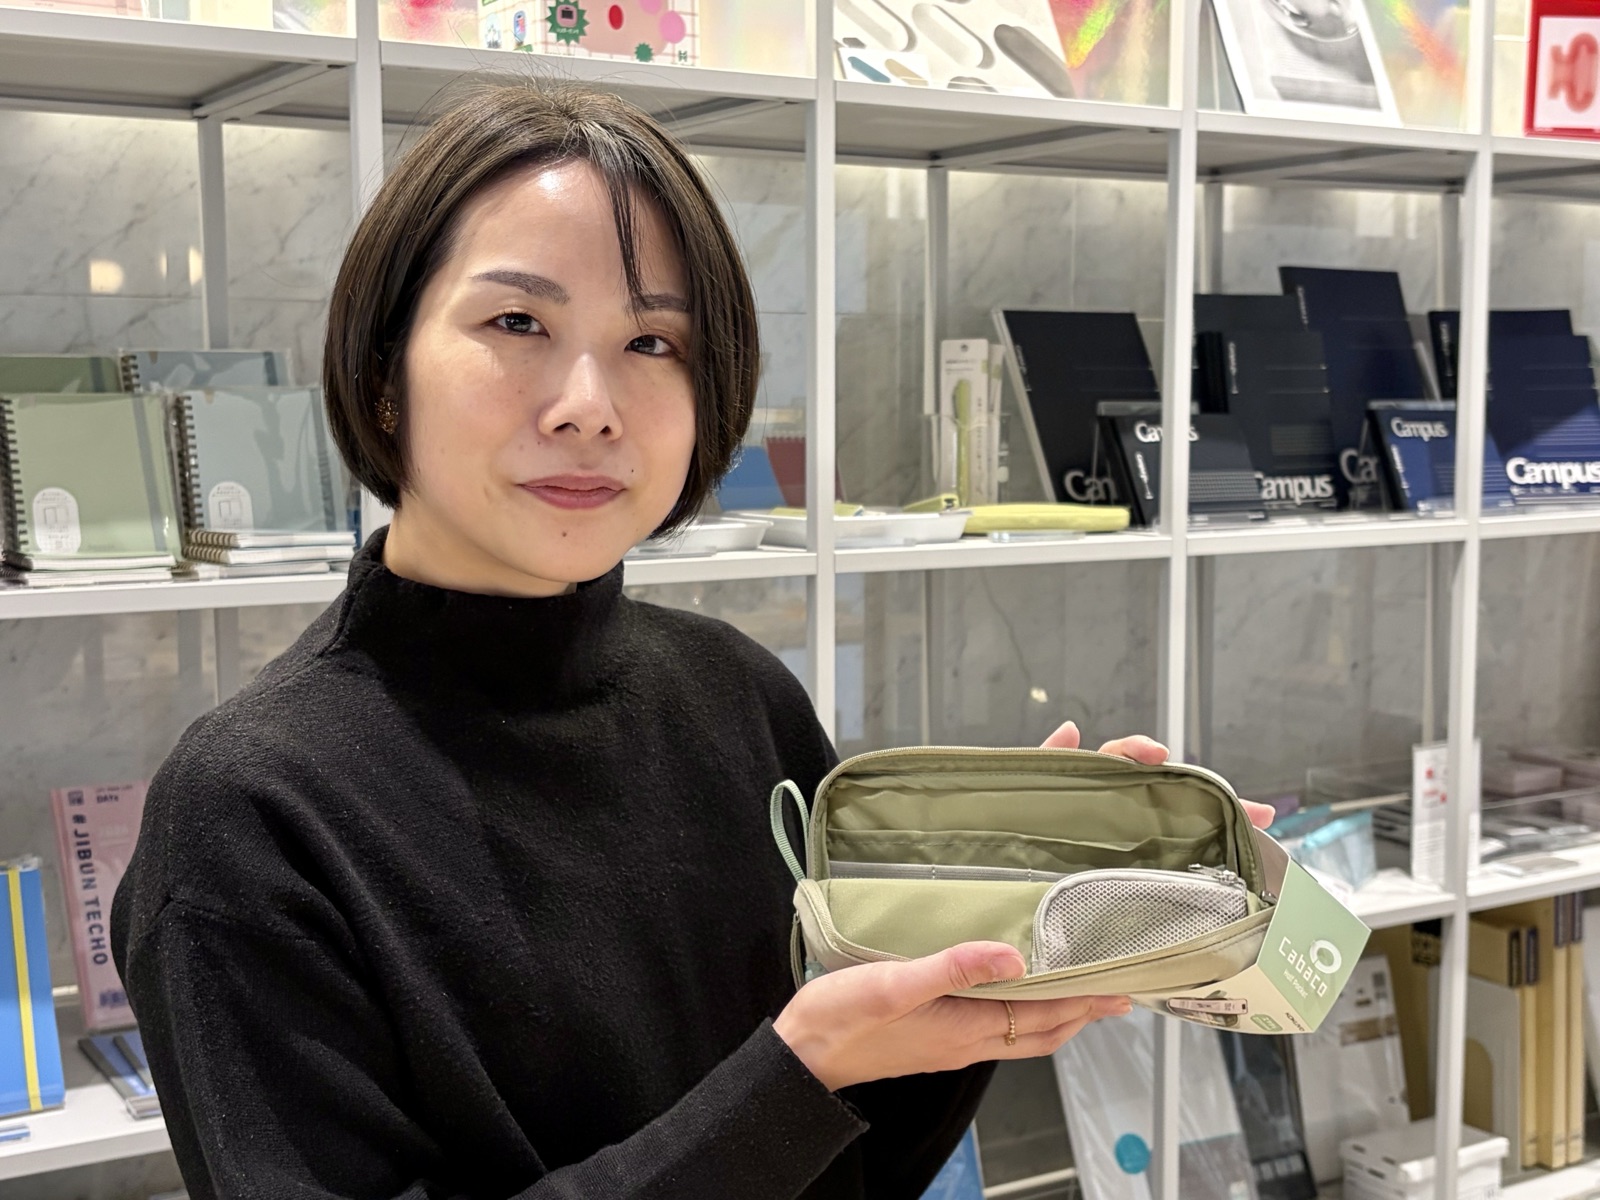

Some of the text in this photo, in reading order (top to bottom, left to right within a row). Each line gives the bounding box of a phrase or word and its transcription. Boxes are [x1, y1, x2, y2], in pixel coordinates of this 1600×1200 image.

[1391, 416, 1449, 441] Campus
[1255, 471, 1333, 505] ampus
[1506, 457, 1600, 490] Campus
[85, 897, 108, 966] TECHO
[1279, 936, 1328, 998] Cabaco
